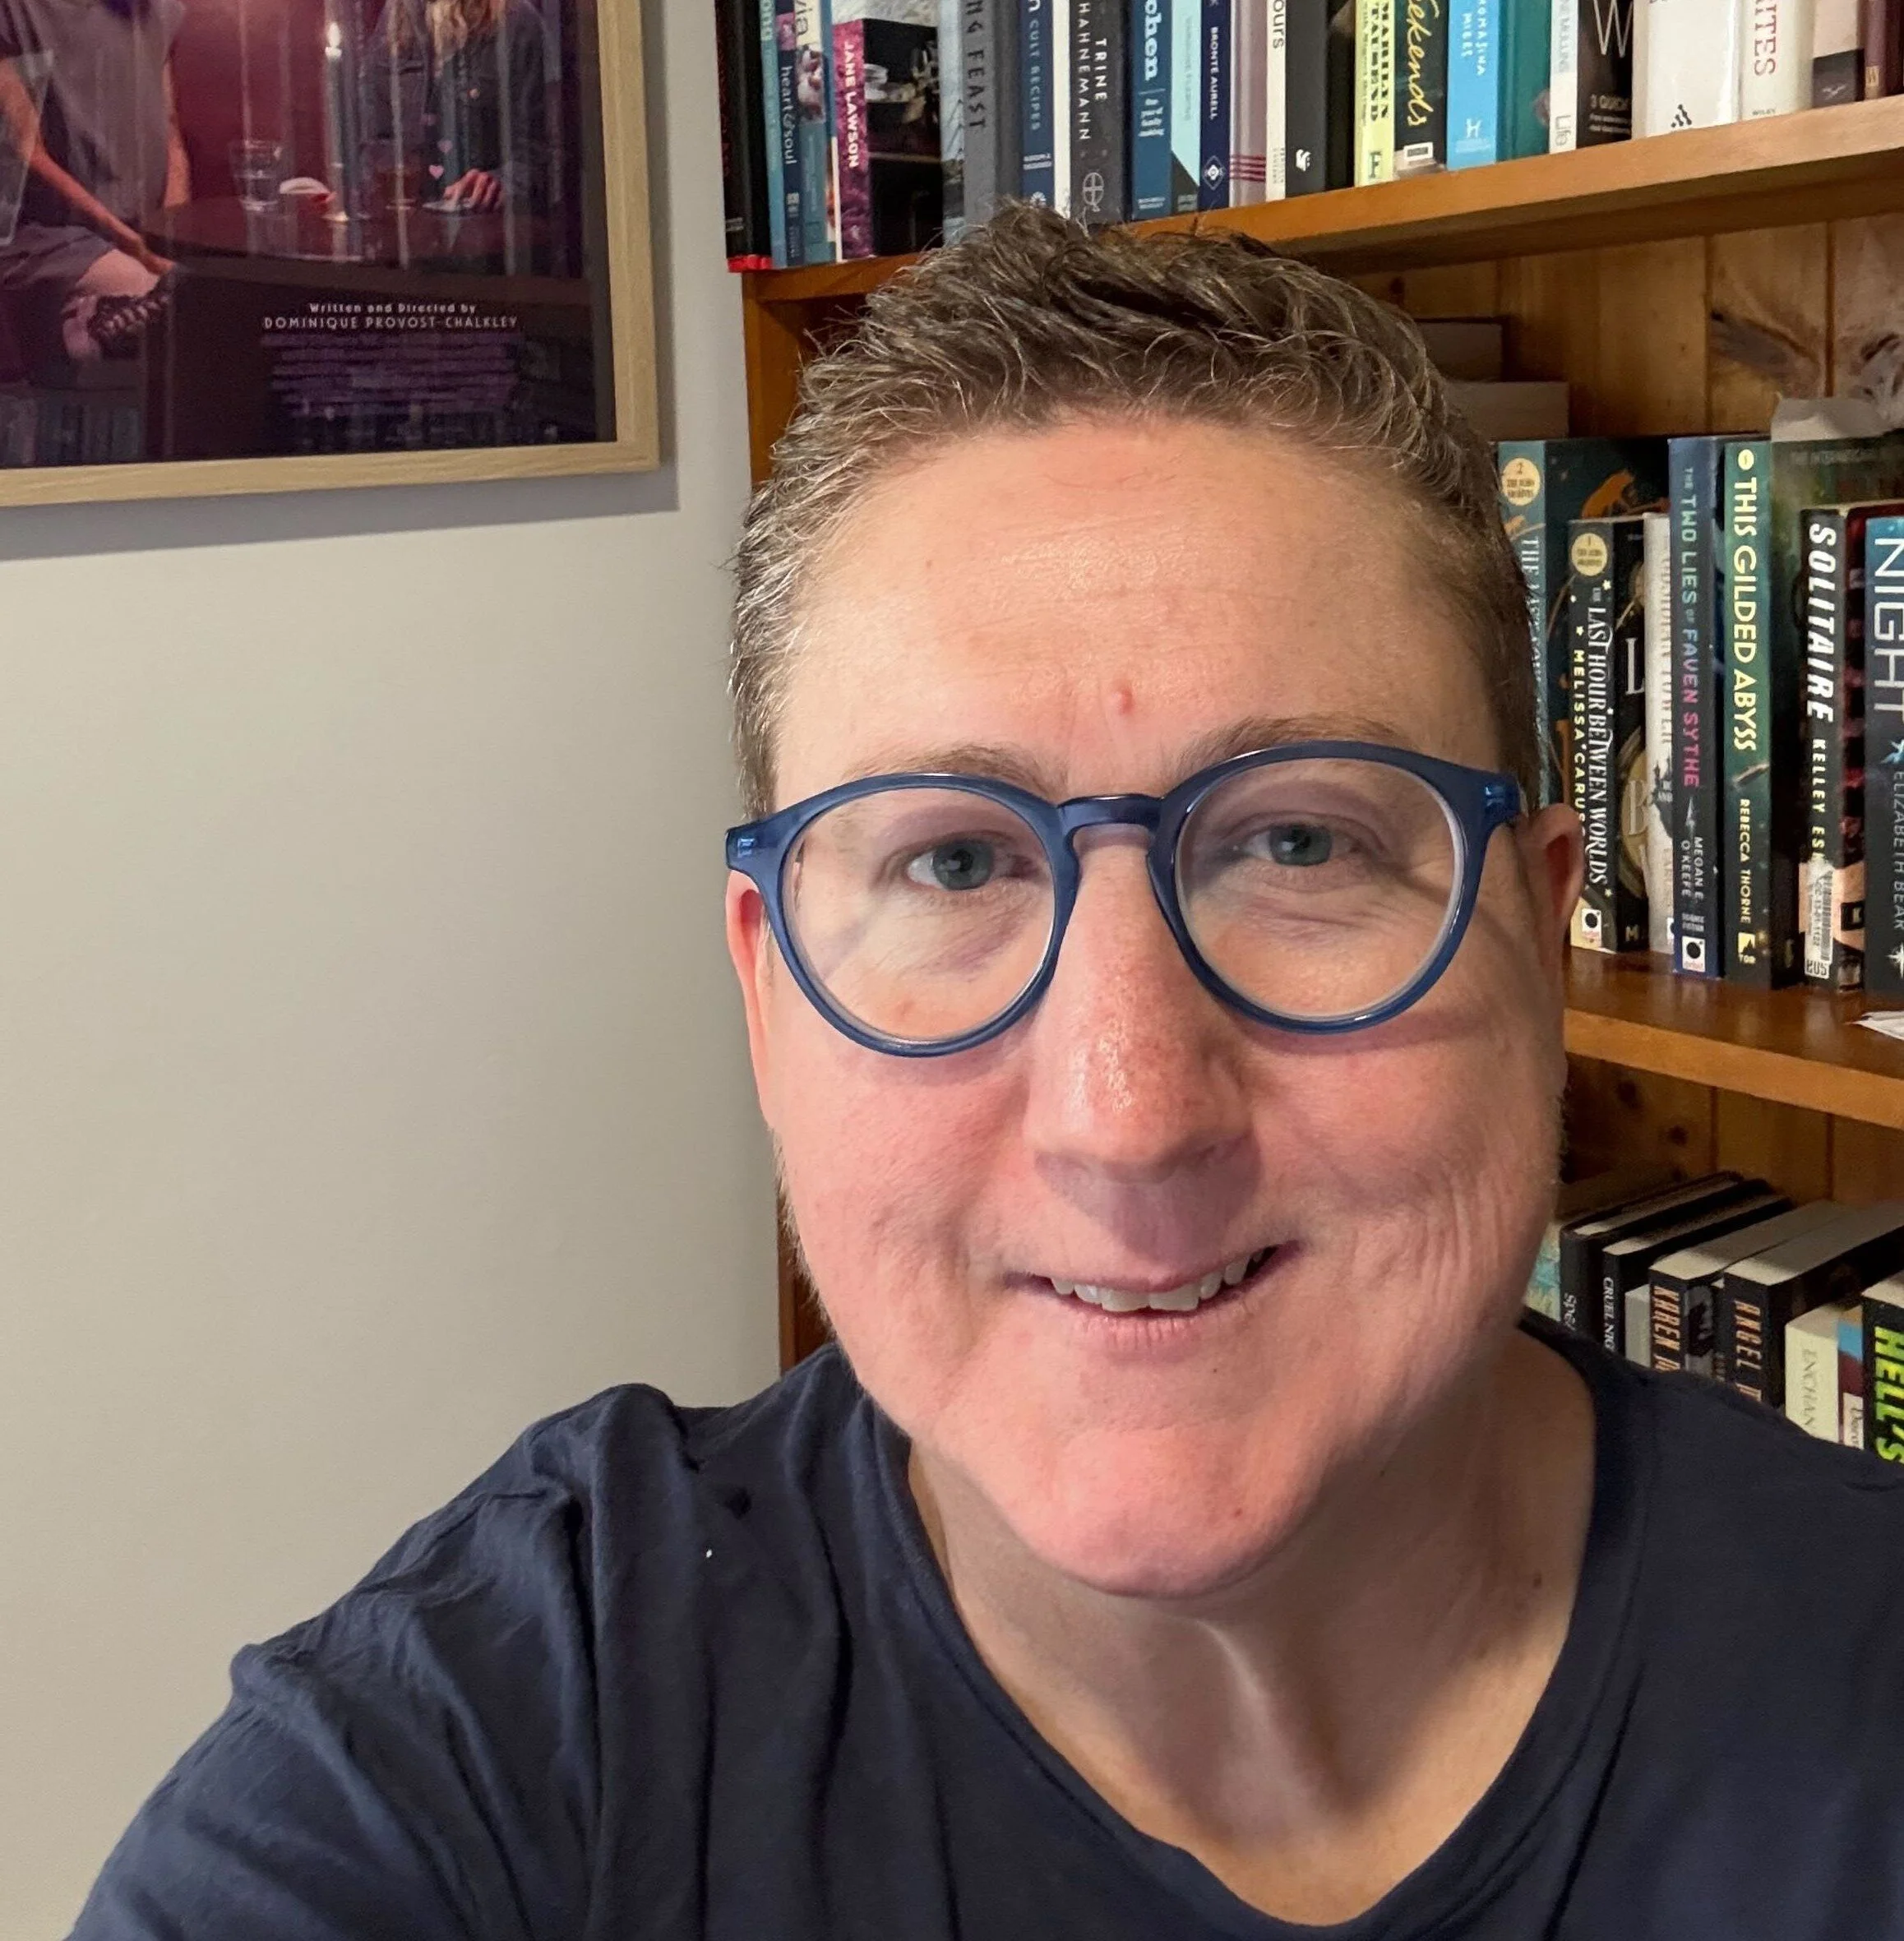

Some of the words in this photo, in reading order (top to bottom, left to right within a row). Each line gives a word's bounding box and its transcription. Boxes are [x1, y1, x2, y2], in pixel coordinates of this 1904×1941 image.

[843, 41, 858, 88] JANE
[1028, 20, 1041, 58] CULT
[1077, 2, 1092, 141] HAHNEMANN
[1094, 38, 1108, 102] TRINE
[1754, 0, 1777, 77] ITES
[968, 49, 987, 128] FEAST
[1030, 65, 1042, 131] RECIPES
[1208, 78, 1220, 121] AURELL
[845, 90, 860, 169] LAWSON
[264, 317, 357, 330] DOMINIQUE
[309, 303, 362, 313] Written
[367, 303, 392, 313] and
[398, 303, 455, 313] Directed
[460, 303, 477, 315] by
[1680, 494, 1698, 543] TWO
[1734, 478, 1758, 536] THIS
[1680, 550, 1698, 604] LIES
[1733, 545, 1758, 664] GILDED
[1587, 607, 1614, 654] LAST
[1806, 523, 1837, 723] SOLITAIRE
[1874, 538, 1904, 723] NIGHT
[1573, 649, 1587, 742] MELISSA
[1587, 654, 1608, 710] HOUR
[1681, 628, 1699, 705] FAVEN
[1732, 668, 1758, 751] ABYSS
[1587, 714, 1614, 802] BETWEEN
[1681, 711, 1701, 788] SYTHE
[1811, 738, 1827, 813] KELLEY
[1585, 806, 1609, 885] WORLDS
[1739, 798, 1751, 863] REBECCA
[1892, 770, 1904, 873] ELIZABETH
[1694, 836, 1704, 887] MEGAN
[1740, 868, 1752, 924] THORNE
[1893, 880, 1904, 930] BEAR
[1603, 1277, 1615, 1319] CRUEL
[1653, 1285, 1681, 1351] KAREN
[1734, 1300, 1762, 1370] ANGEL
[1874, 1325, 1904, 1465] HELL'S
